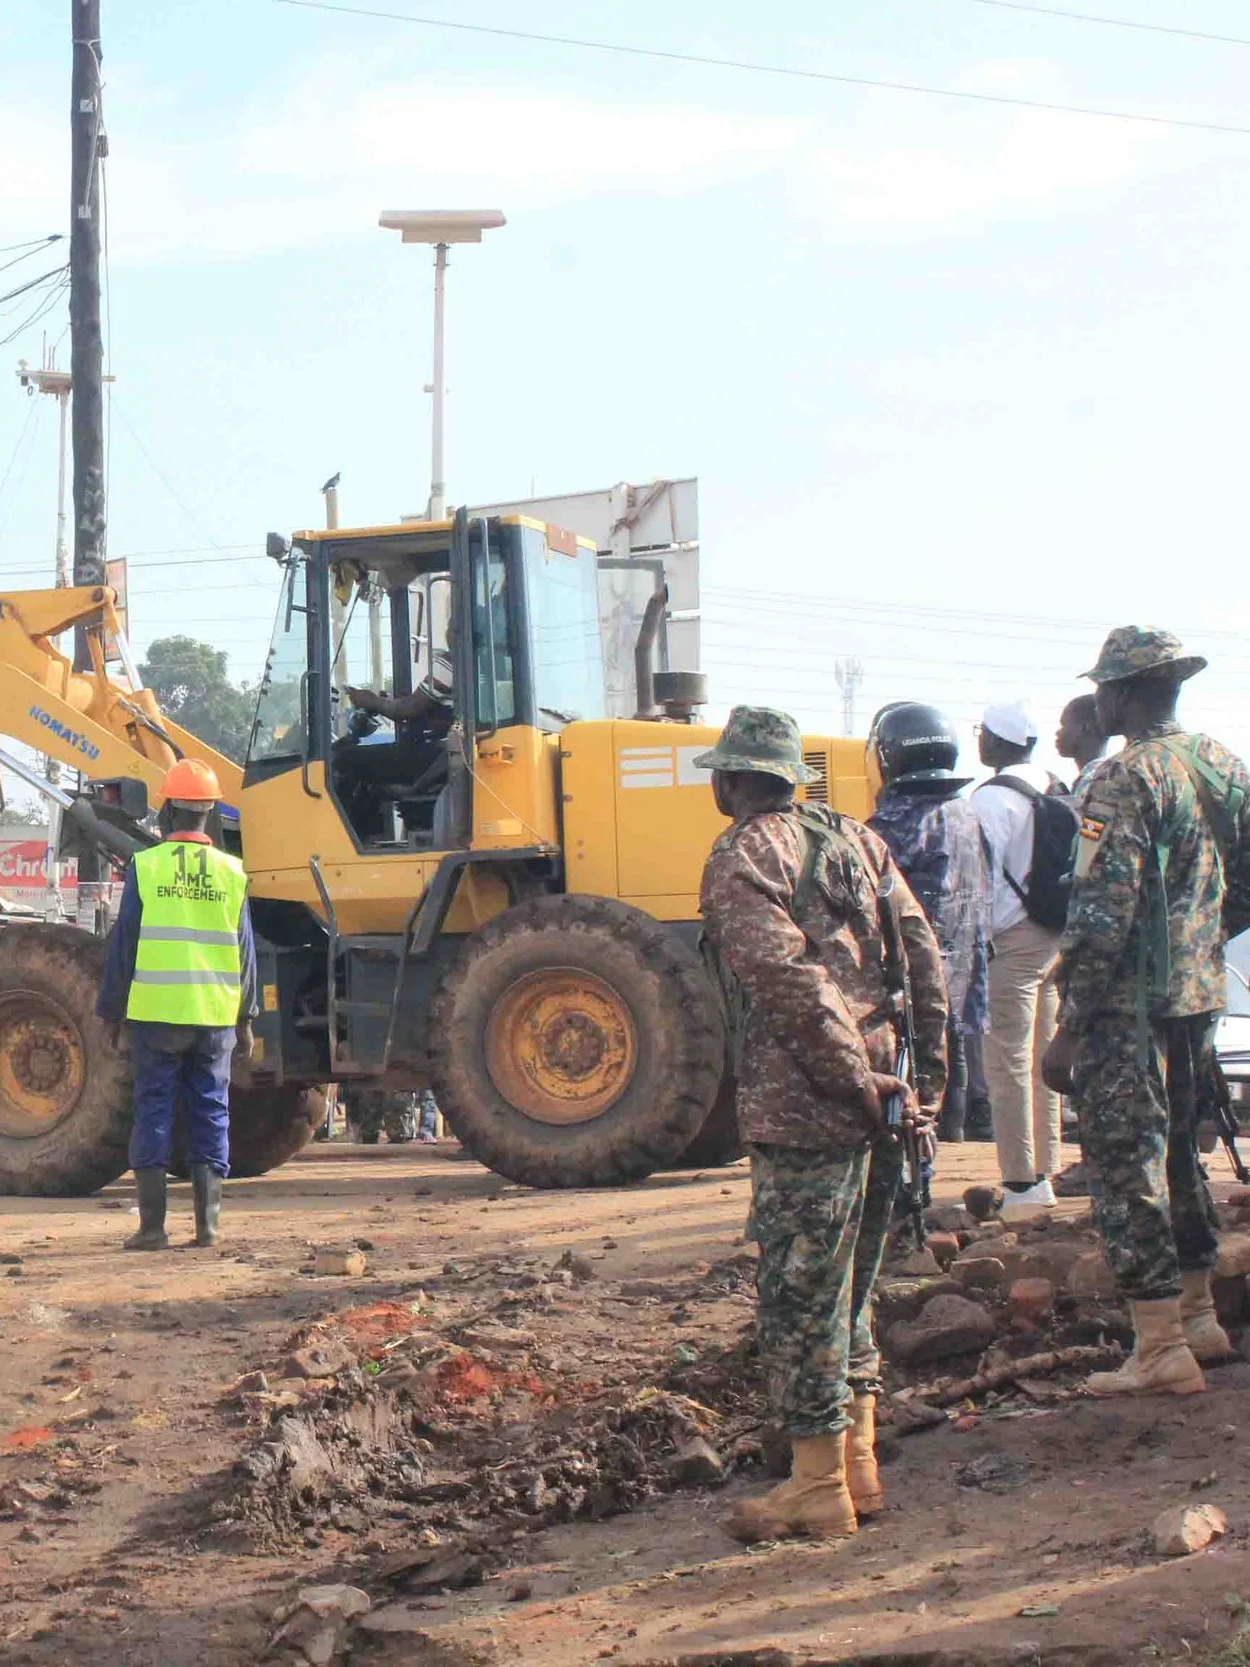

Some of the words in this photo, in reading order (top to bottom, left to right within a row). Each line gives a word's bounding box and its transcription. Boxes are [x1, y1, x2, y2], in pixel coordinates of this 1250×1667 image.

[171, 845, 207, 875] 11
[174, 872, 213, 888] MMC
[157, 886, 228, 902] ENFORCEMENT
